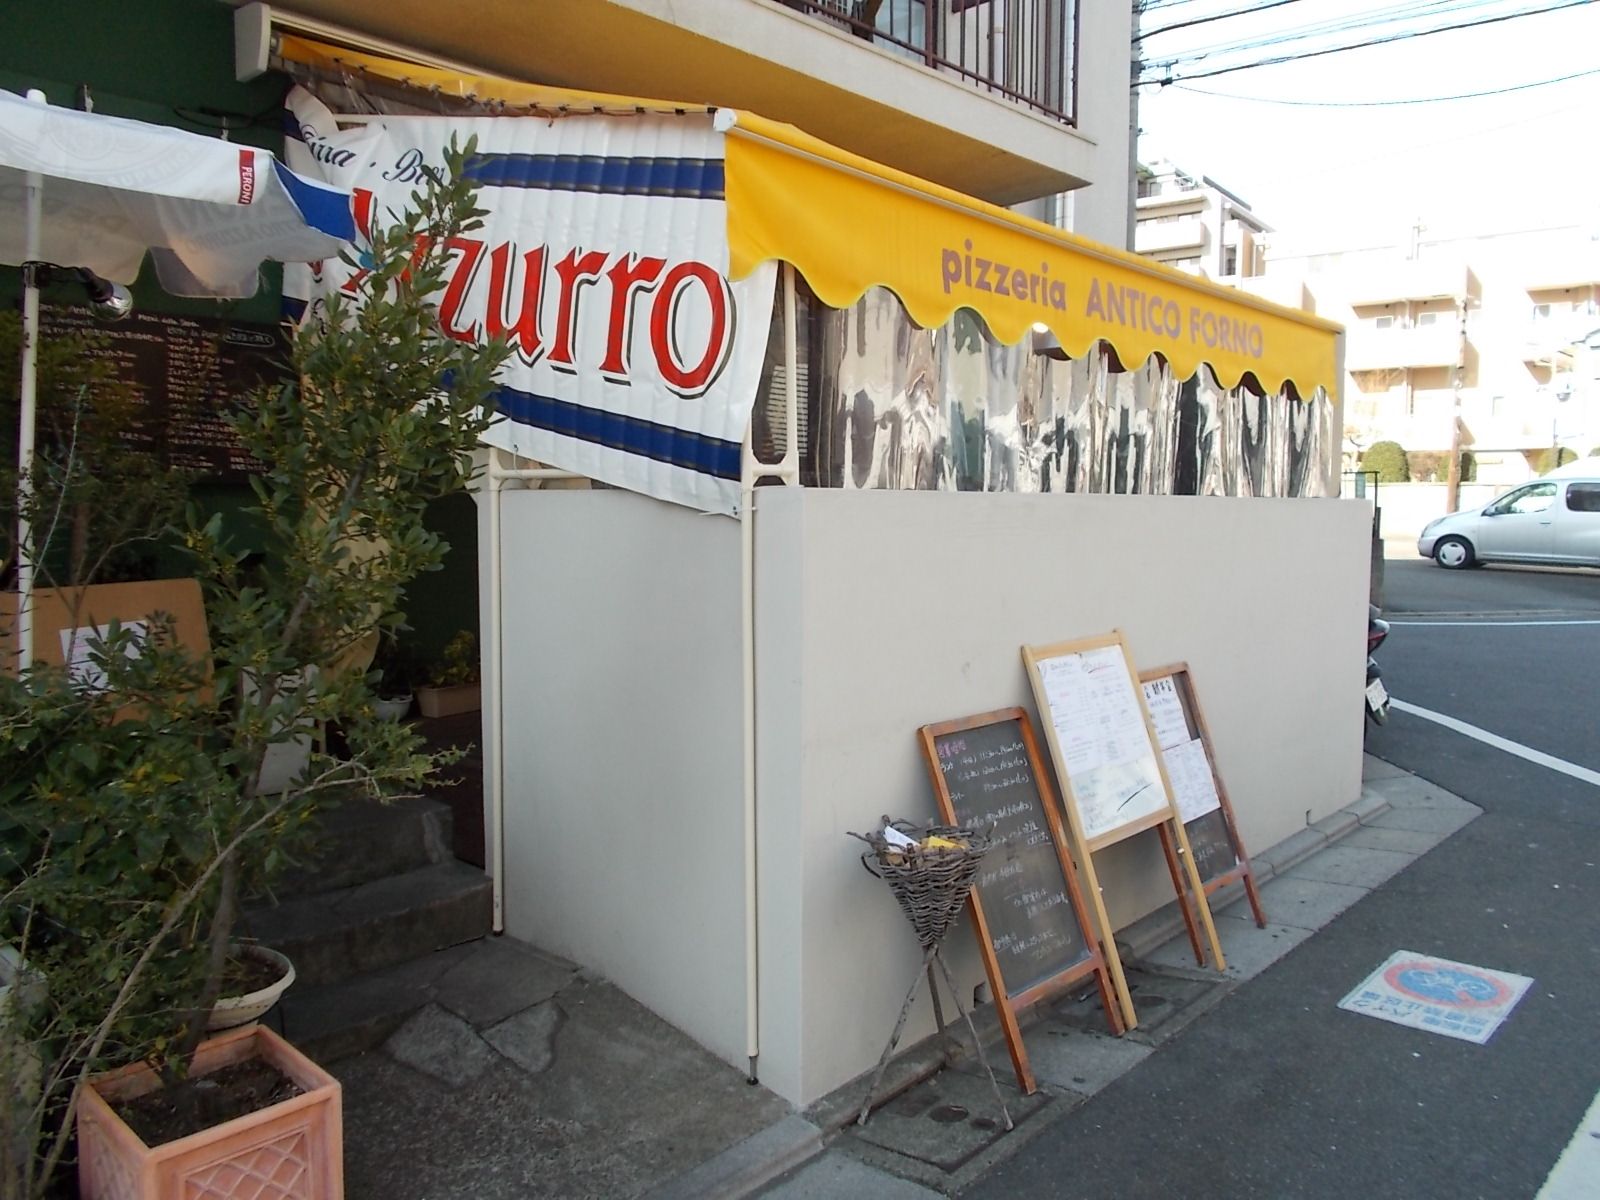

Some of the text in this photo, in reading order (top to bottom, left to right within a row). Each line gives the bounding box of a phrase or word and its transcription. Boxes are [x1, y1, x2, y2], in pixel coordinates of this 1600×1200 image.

[239, 166, 254, 204] PERONI
[941, 239, 1264, 359] pizzeria ANTICO FORNO
